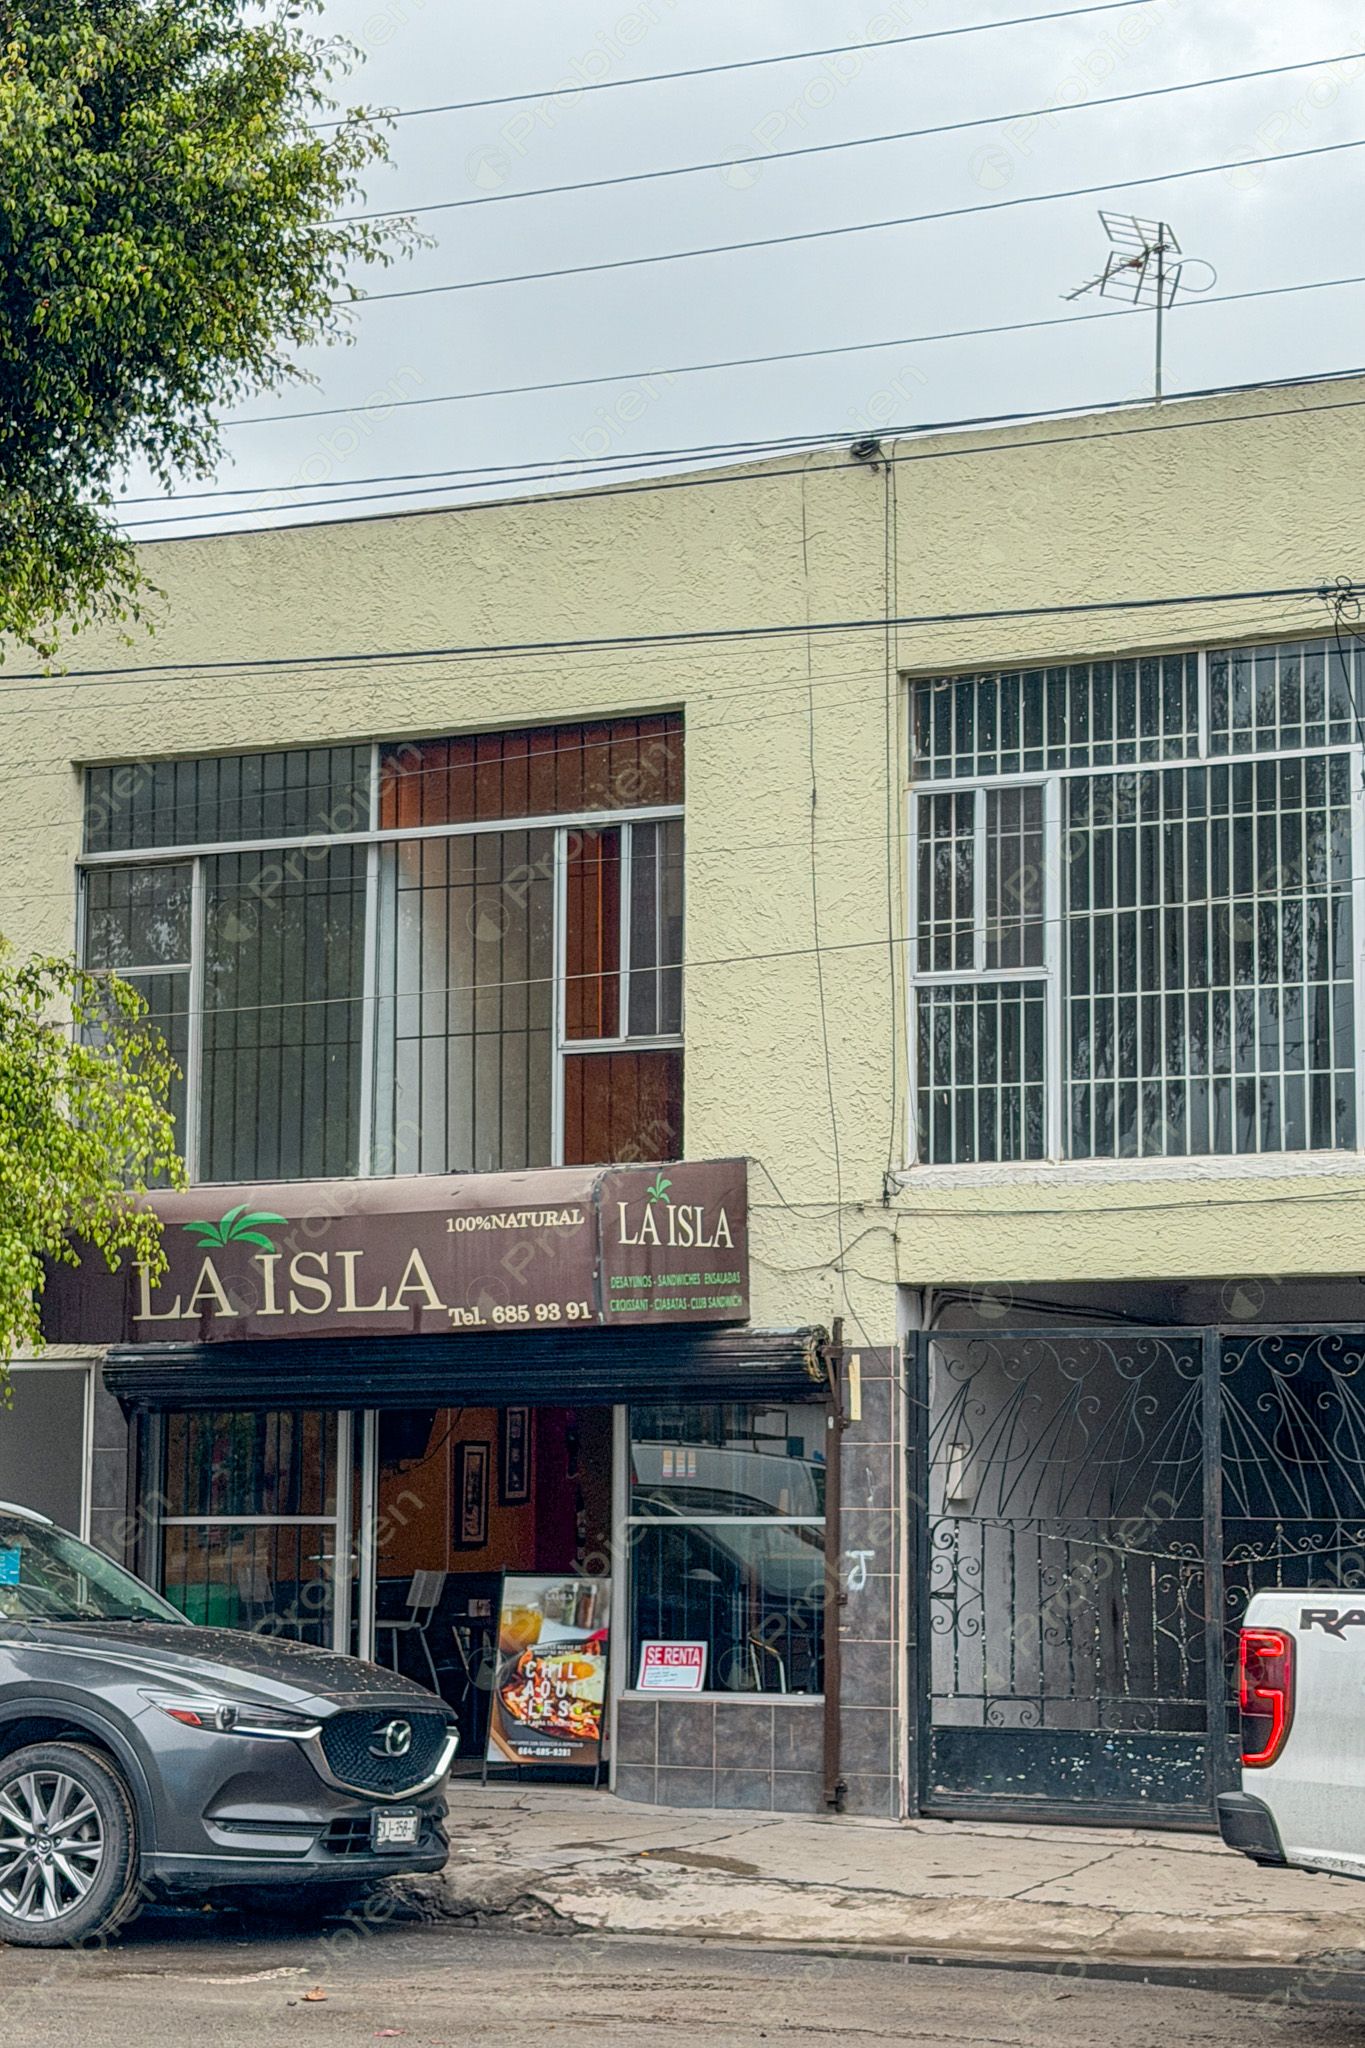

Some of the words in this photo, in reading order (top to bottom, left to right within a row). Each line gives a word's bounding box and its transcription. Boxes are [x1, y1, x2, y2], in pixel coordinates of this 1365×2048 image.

[446, 1209, 585, 1233] 100%NATURAL
[617, 1201, 662, 1246] LA
[666, 1205, 735, 1249] ISLA
[132, 1256, 239, 1321] LA
[254, 1247, 448, 1315] ISLA
[610, 1275, 652, 1289] DESAYUNOS
[657, 1272, 701, 1287] SANDWICHES
[704, 1271, 740, 1285] ENSALADAS
[610, 1298, 649, 1312] CROISSANT
[708, 1295, 743, 1309] SANDWICH
[448, 1306, 487, 1327] Tel.
[492, 1304, 530, 1324] 685
[534, 1302, 561, 1322] 93
[565, 1301, 593, 1320] 91
[646, 1646, 663, 1665] SE
[664, 1647, 701, 1665] RENTA
[525, 1661, 578, 1678] CHIL
[523, 1680, 578, 1698] AQUI
[528, 1699, 569, 1717] LES
